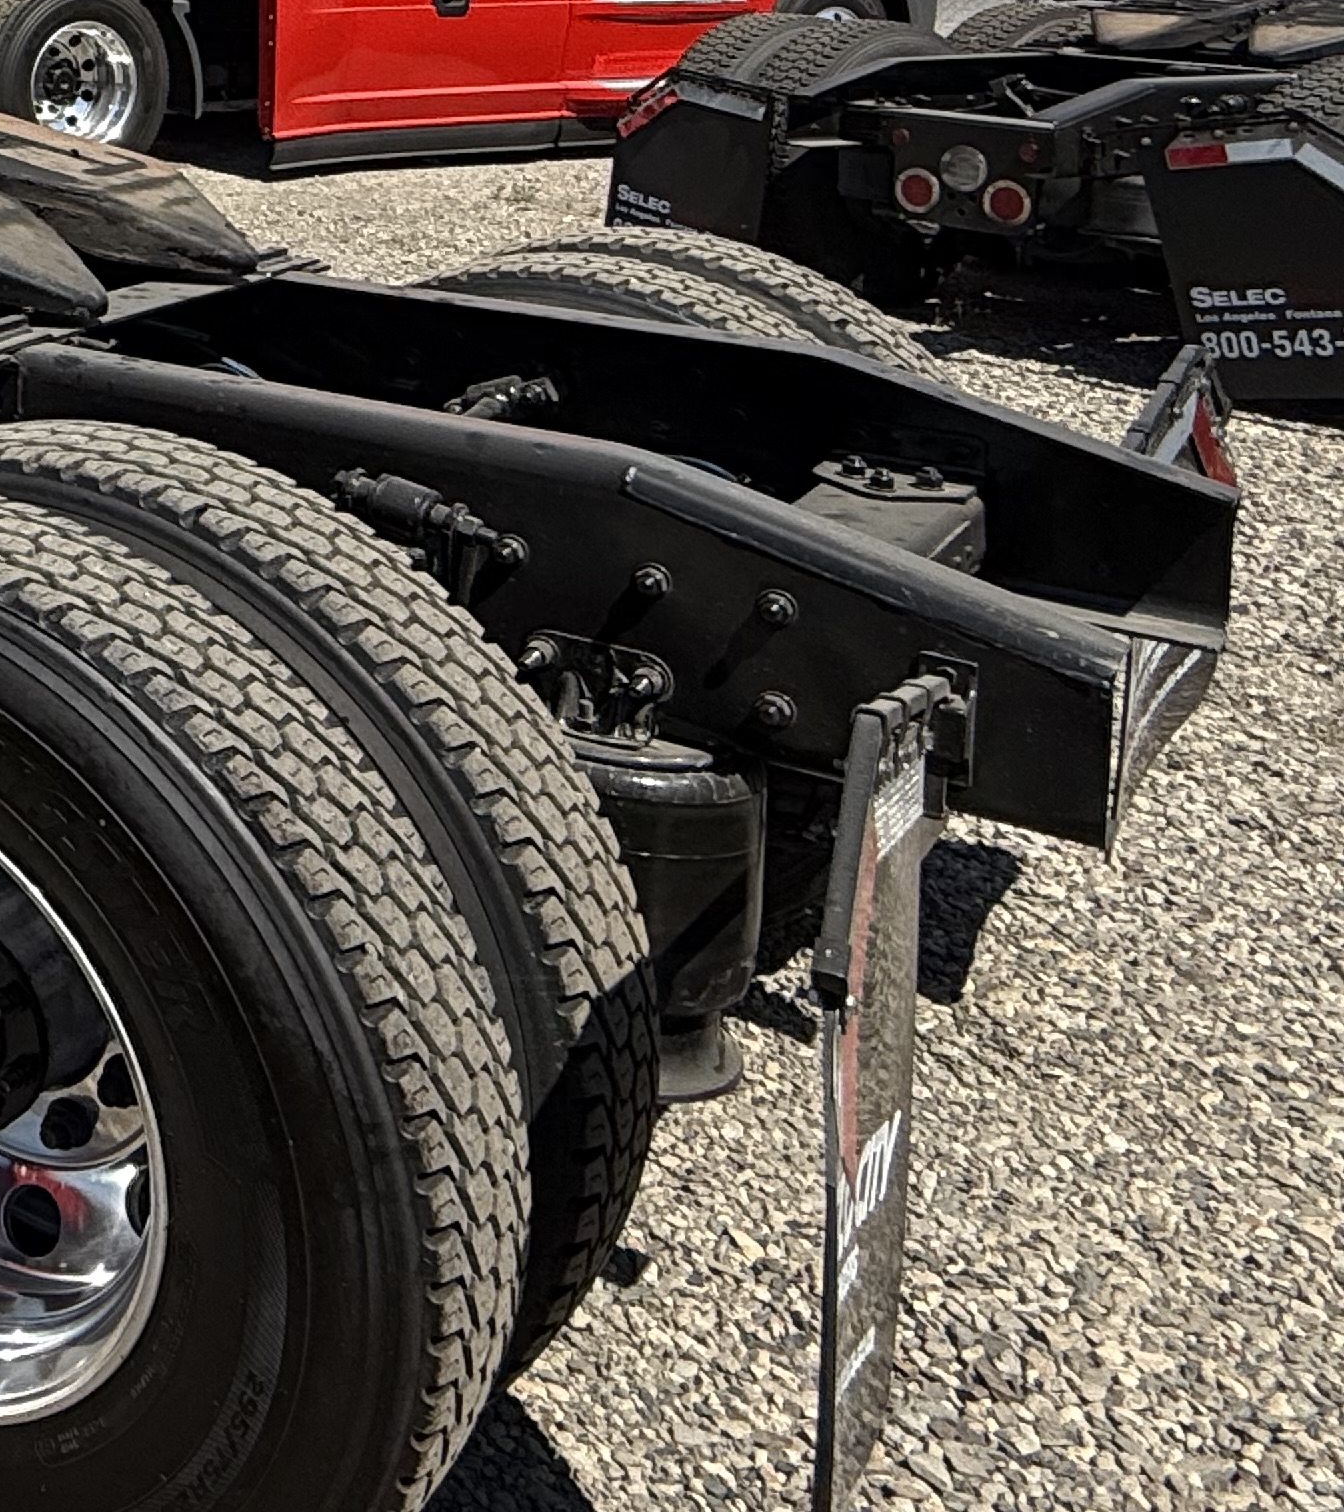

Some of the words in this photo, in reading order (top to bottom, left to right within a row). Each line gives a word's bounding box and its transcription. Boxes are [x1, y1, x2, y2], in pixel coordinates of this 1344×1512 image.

[1189, 287, 1287, 308] SELEC
[1223, 311, 1277, 324] Angeles
[1201, 328, 1344, 360] 800-543-
